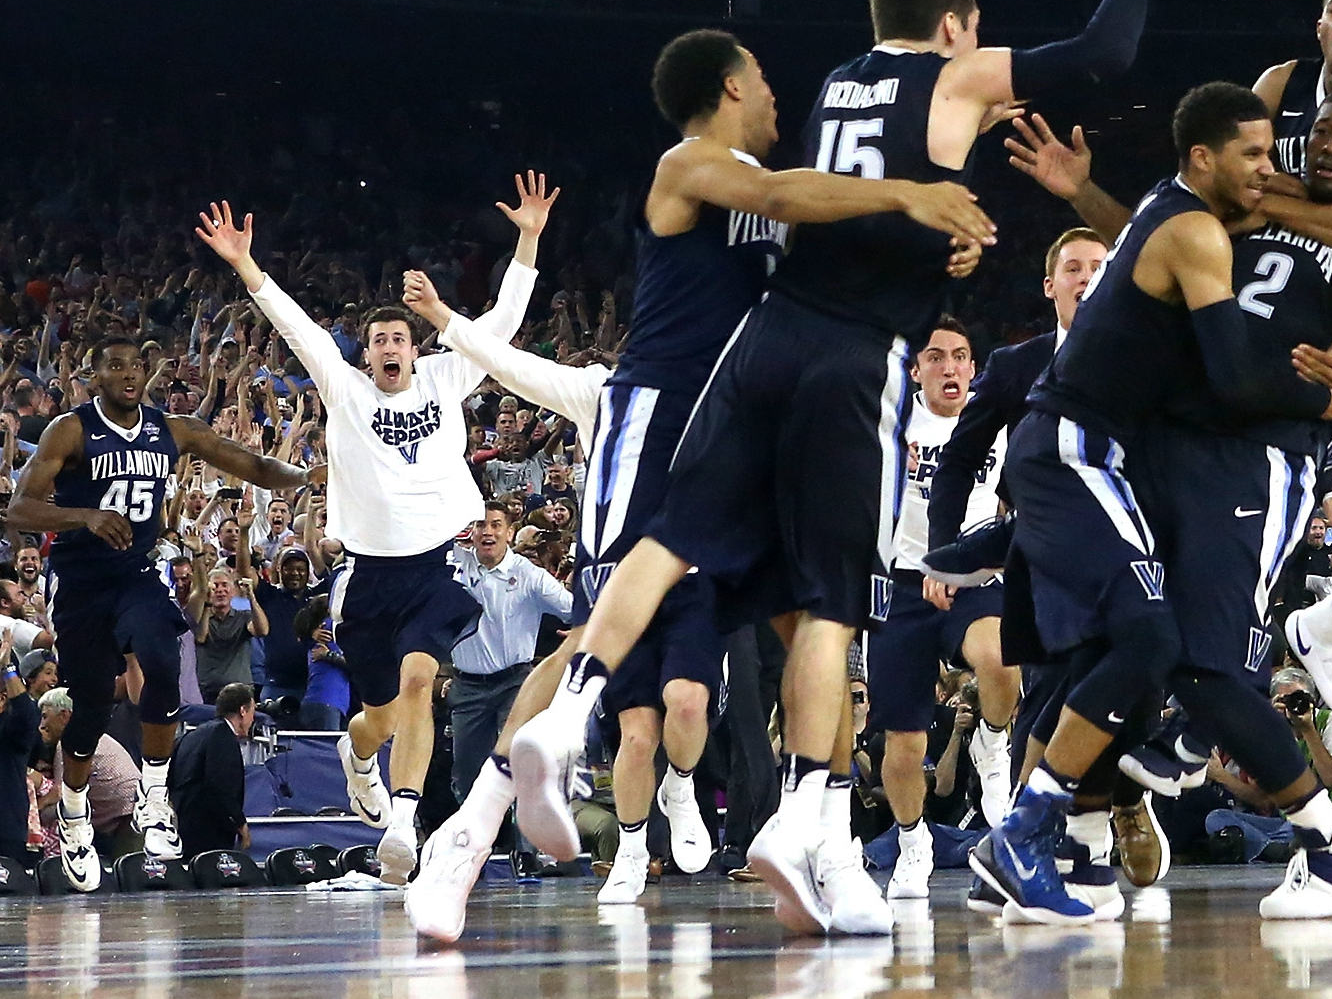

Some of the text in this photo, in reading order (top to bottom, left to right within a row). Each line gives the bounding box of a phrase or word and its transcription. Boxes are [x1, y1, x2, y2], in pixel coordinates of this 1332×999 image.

[816, 118, 885, 180] 15
[1238, 251, 1294, 320] 2
[91, 449, 169, 480] VILLANOVA
[99, 480, 156, 522] 45
